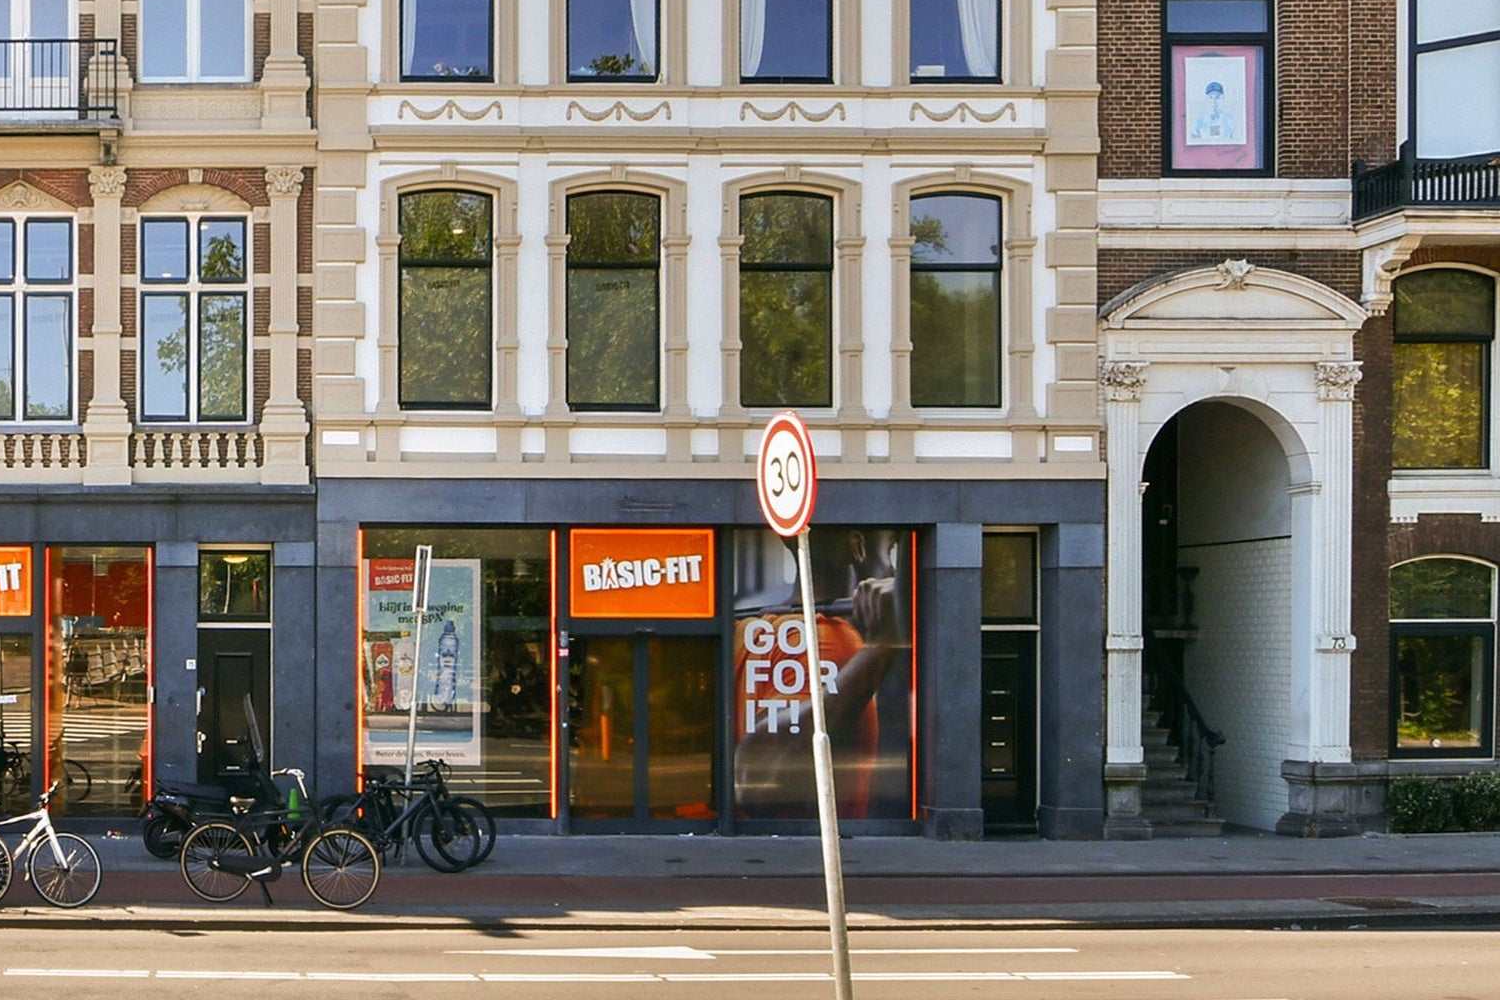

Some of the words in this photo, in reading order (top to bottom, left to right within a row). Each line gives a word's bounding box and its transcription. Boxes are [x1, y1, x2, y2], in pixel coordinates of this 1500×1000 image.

[770, 451, 801, 498] 30
[582, 554, 702, 592] BASIC-FIT
[744, 619, 808, 655] GO
[1332, 637, 1346, 649] 73
[745, 659, 838, 694] FOR
[745, 699, 801, 734] IT!
